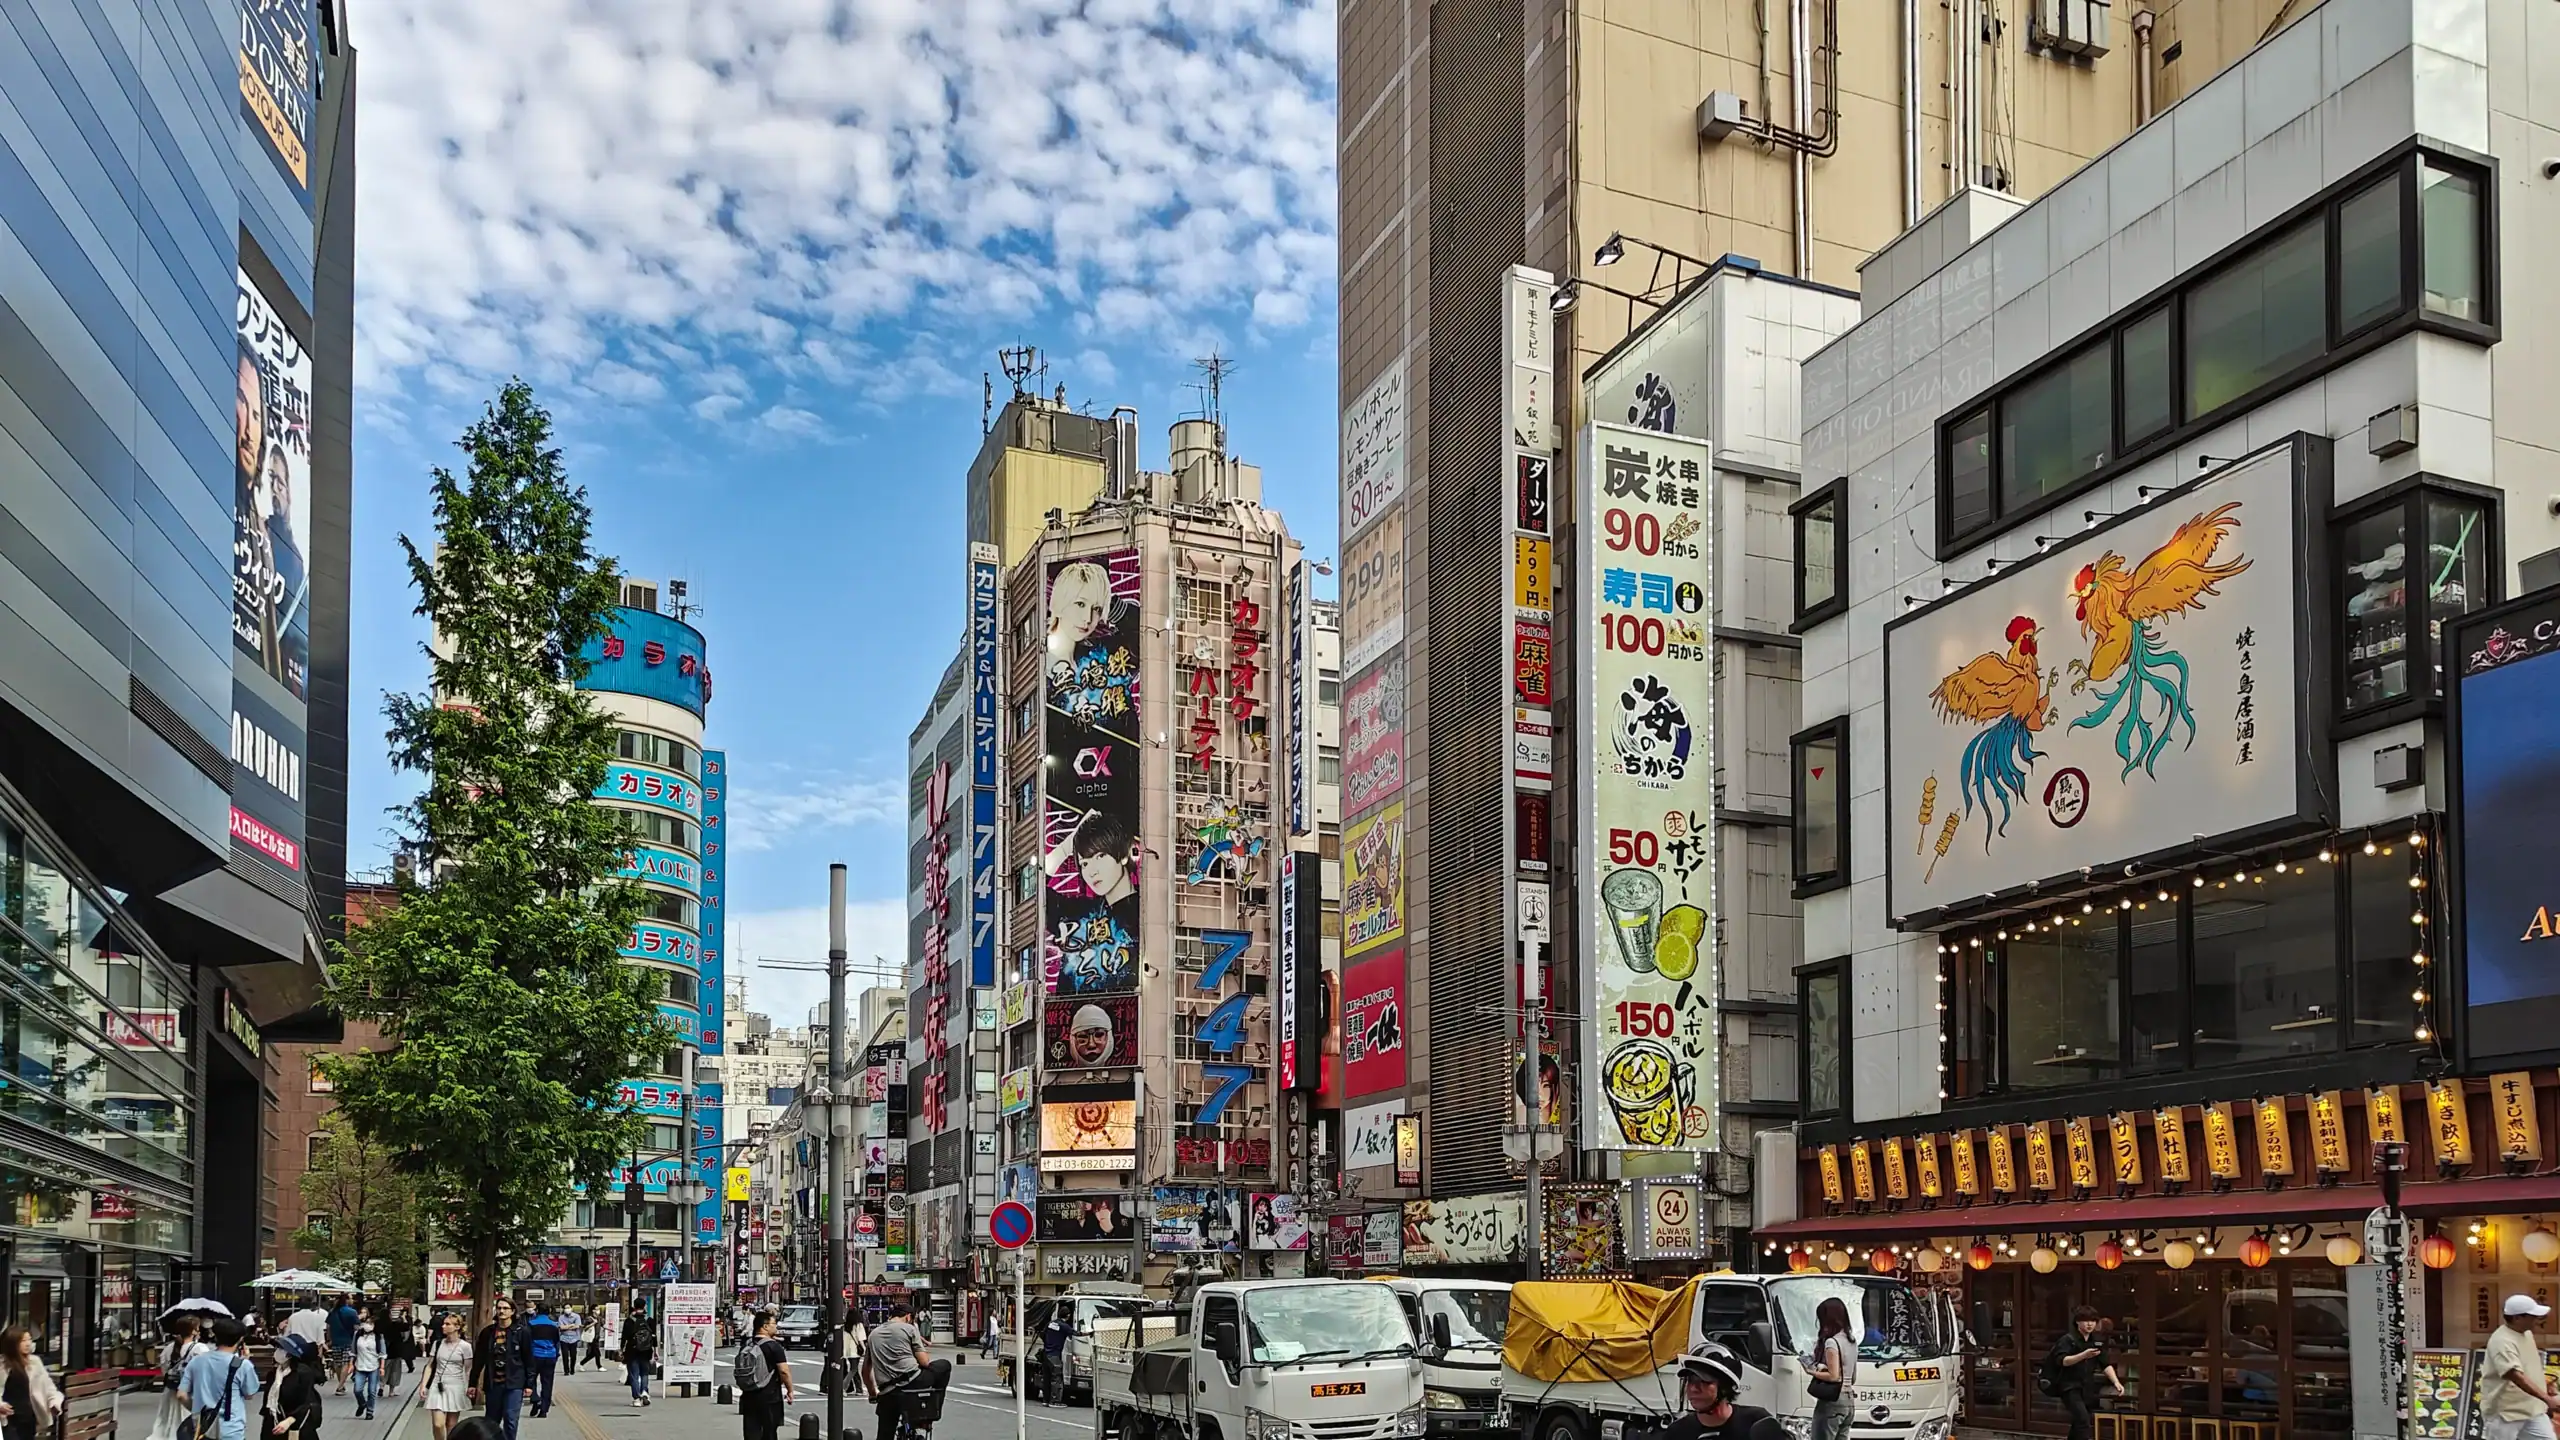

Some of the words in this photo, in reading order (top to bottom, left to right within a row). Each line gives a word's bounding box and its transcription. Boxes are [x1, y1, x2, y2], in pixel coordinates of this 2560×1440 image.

[258, 42, 306, 142] OPEN
[1346, 372, 1402, 441] ハイボール
[1346, 403, 1402, 466] レモンサワー
[1345, 430, 1403, 492] 豆挽きコーヒー
[1528, 459, 1548, 517] ダーツ
[1603, 443, 1652, 504] 炭
[1519, 456, 1529, 529] HIDEOUT
[1531, 517, 1545, 532] 8F
[1603, 507, 1662, 557] 90
[1662, 540, 1699, 560] 円から
[1526, 540, 1540, 606] 299円
[1603, 566, 1674, 615] 寿司
[1682, 583, 1696, 598] 21
[1517, 608, 1540, 620] 九十九
[1600, 612, 1666, 657] 100
[1667, 643, 1704, 662] 円から
[974, 567, 996, 774] カラオケ&パーティー
[1230, 596, 1261, 722] カラオケ
[1516, 639, 1550, 697] 麻雀
[1190, 666, 1222, 773] パーティ
[2233, 624, 2256, 767] 焼き鳥居酒屋
[1623, 754, 1686, 781] ちから
[1640, 736, 1656, 752] の
[1075, 782, 1109, 796] alpha
[1359, 816, 1387, 867] 低料金
[1609, 828, 1659, 868] 50
[1657, 863, 1667, 873] 円
[1689, 810, 1707, 873] レモン
[972, 824, 996, 950] 747
[1347, 877, 1377, 918] 麻雀
[1664, 839, 1691, 901] サワー
[703, 760, 721, 1046] カラオケ&パーティー館
[1283, 885, 1297, 1042] 新宿東宝ビル店
[1113, 1005, 1125, 1059] オープン
[1194, 928, 1254, 1126] 747
[1615, 1001, 1675, 1039] 150
[1671, 1035, 1681, 1047] 円
[1675, 980, 1710, 1059] ハイボール
[1400, 1117, 1417, 1169] きづなすし
[2435, 1084, 2463, 1158] 焼き餃子
[2500, 1078, 2531, 1157] 牛すじ煮込み
[1516, 1160, 1559, 1172] マンナ
[1922, 1144, 1941, 1190] 焼鳥
[1955, 1135, 1973, 1190] あん肝ポン酢
[2112, 1117, 2137, 1179] サラダ
[2161, 1115, 2184, 1178] 生牡蠣
[1443, 1203, 1515, 1254] きづなすし
[1554, 1196, 1571, 1270] マドンナ
[1656, 1227, 1692, 1237] ALWAYS
[1663, 1200, 1681, 1218] 24
[1046, 1254, 1130, 1275] 無料案内所
[1656, 1236, 1692, 1248] OPEN
[1313, 1383, 1366, 1397] 高圧ガス
[1859, 1389, 1913, 1402] 日本さけネット
[1894, 1367, 1940, 1381] 高圧ガス
